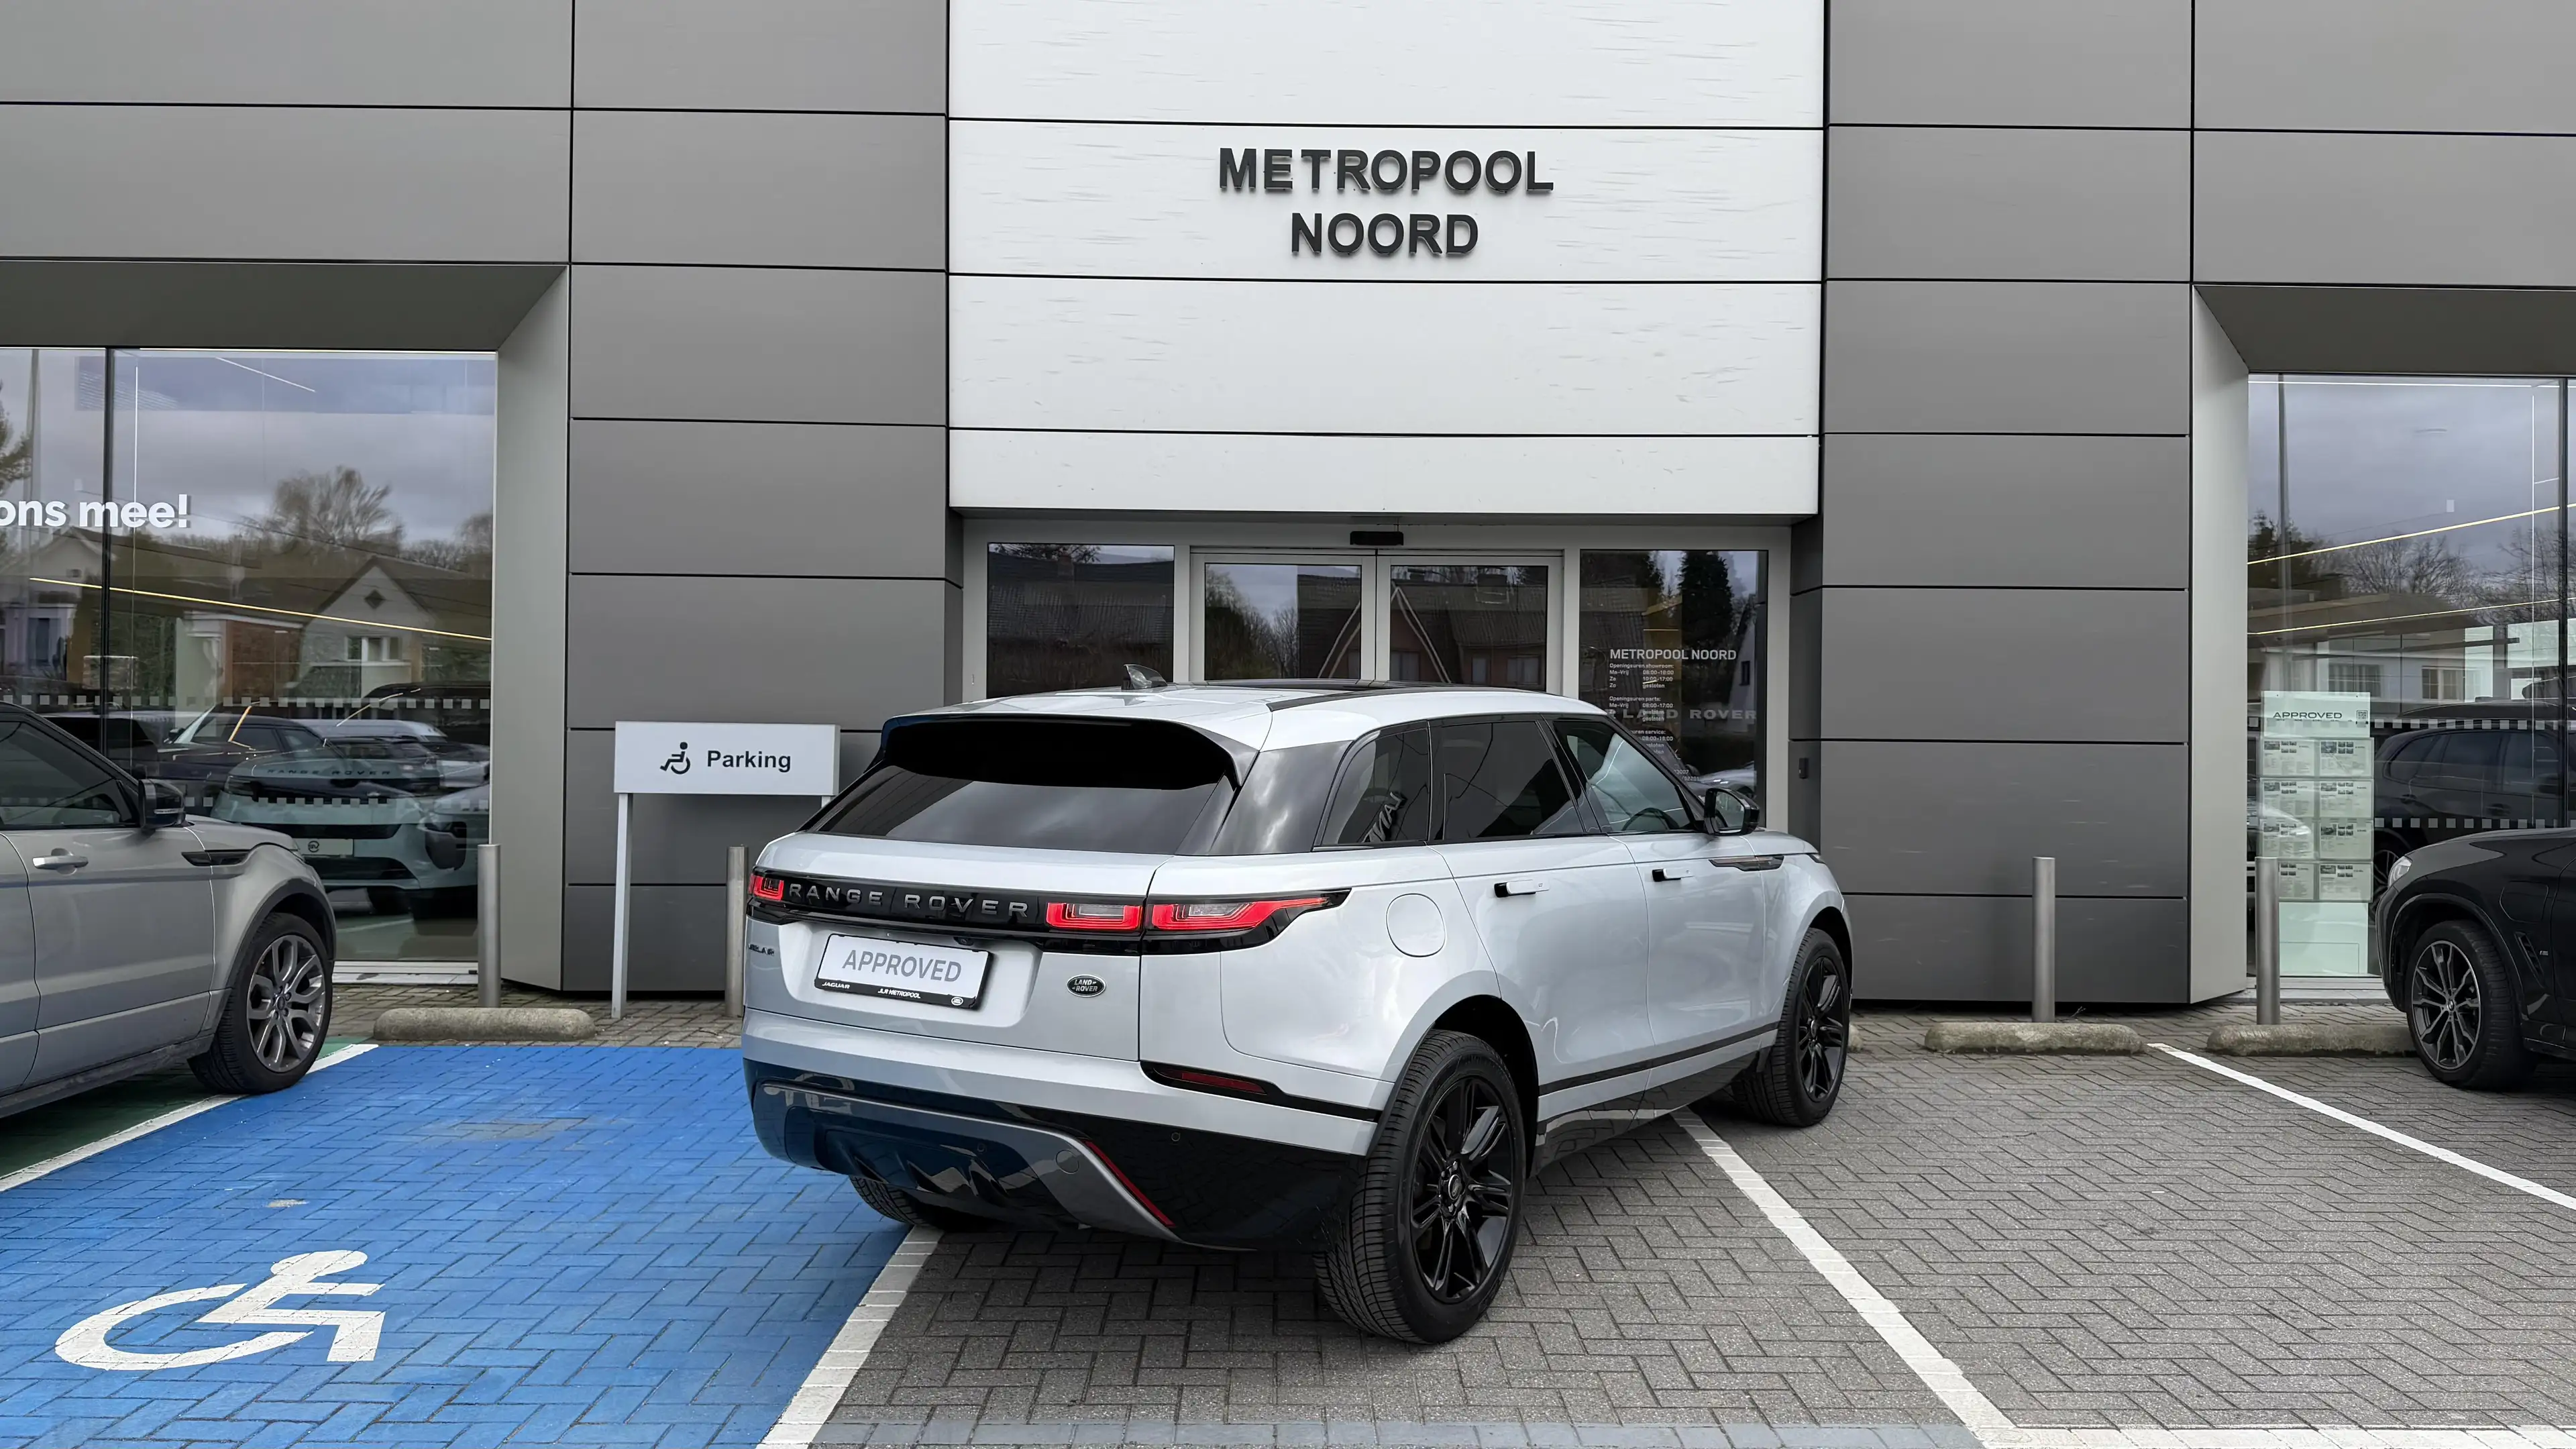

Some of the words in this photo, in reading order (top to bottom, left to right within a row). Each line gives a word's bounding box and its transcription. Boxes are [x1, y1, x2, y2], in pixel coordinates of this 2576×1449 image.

[1219, 148, 1554, 194] METROPOOL
[1291, 213, 1479, 256] NOORD
[0, 500, 67, 527] ons
[79, 494, 189, 528] mee!
[1610, 649, 1689, 660] METROPOOL
[1691, 649, 1737, 661] NOORD
[1689, 709, 1758, 720] ROVER
[707, 750, 792, 773] Parking
[788, 883, 883, 906] RANGE
[904, 894, 1028, 918] ROVER
[842, 949, 962, 983] APPROVED
[822, 981, 851, 989] JAGUAR
[889, 989, 921, 999] METROPOOL
